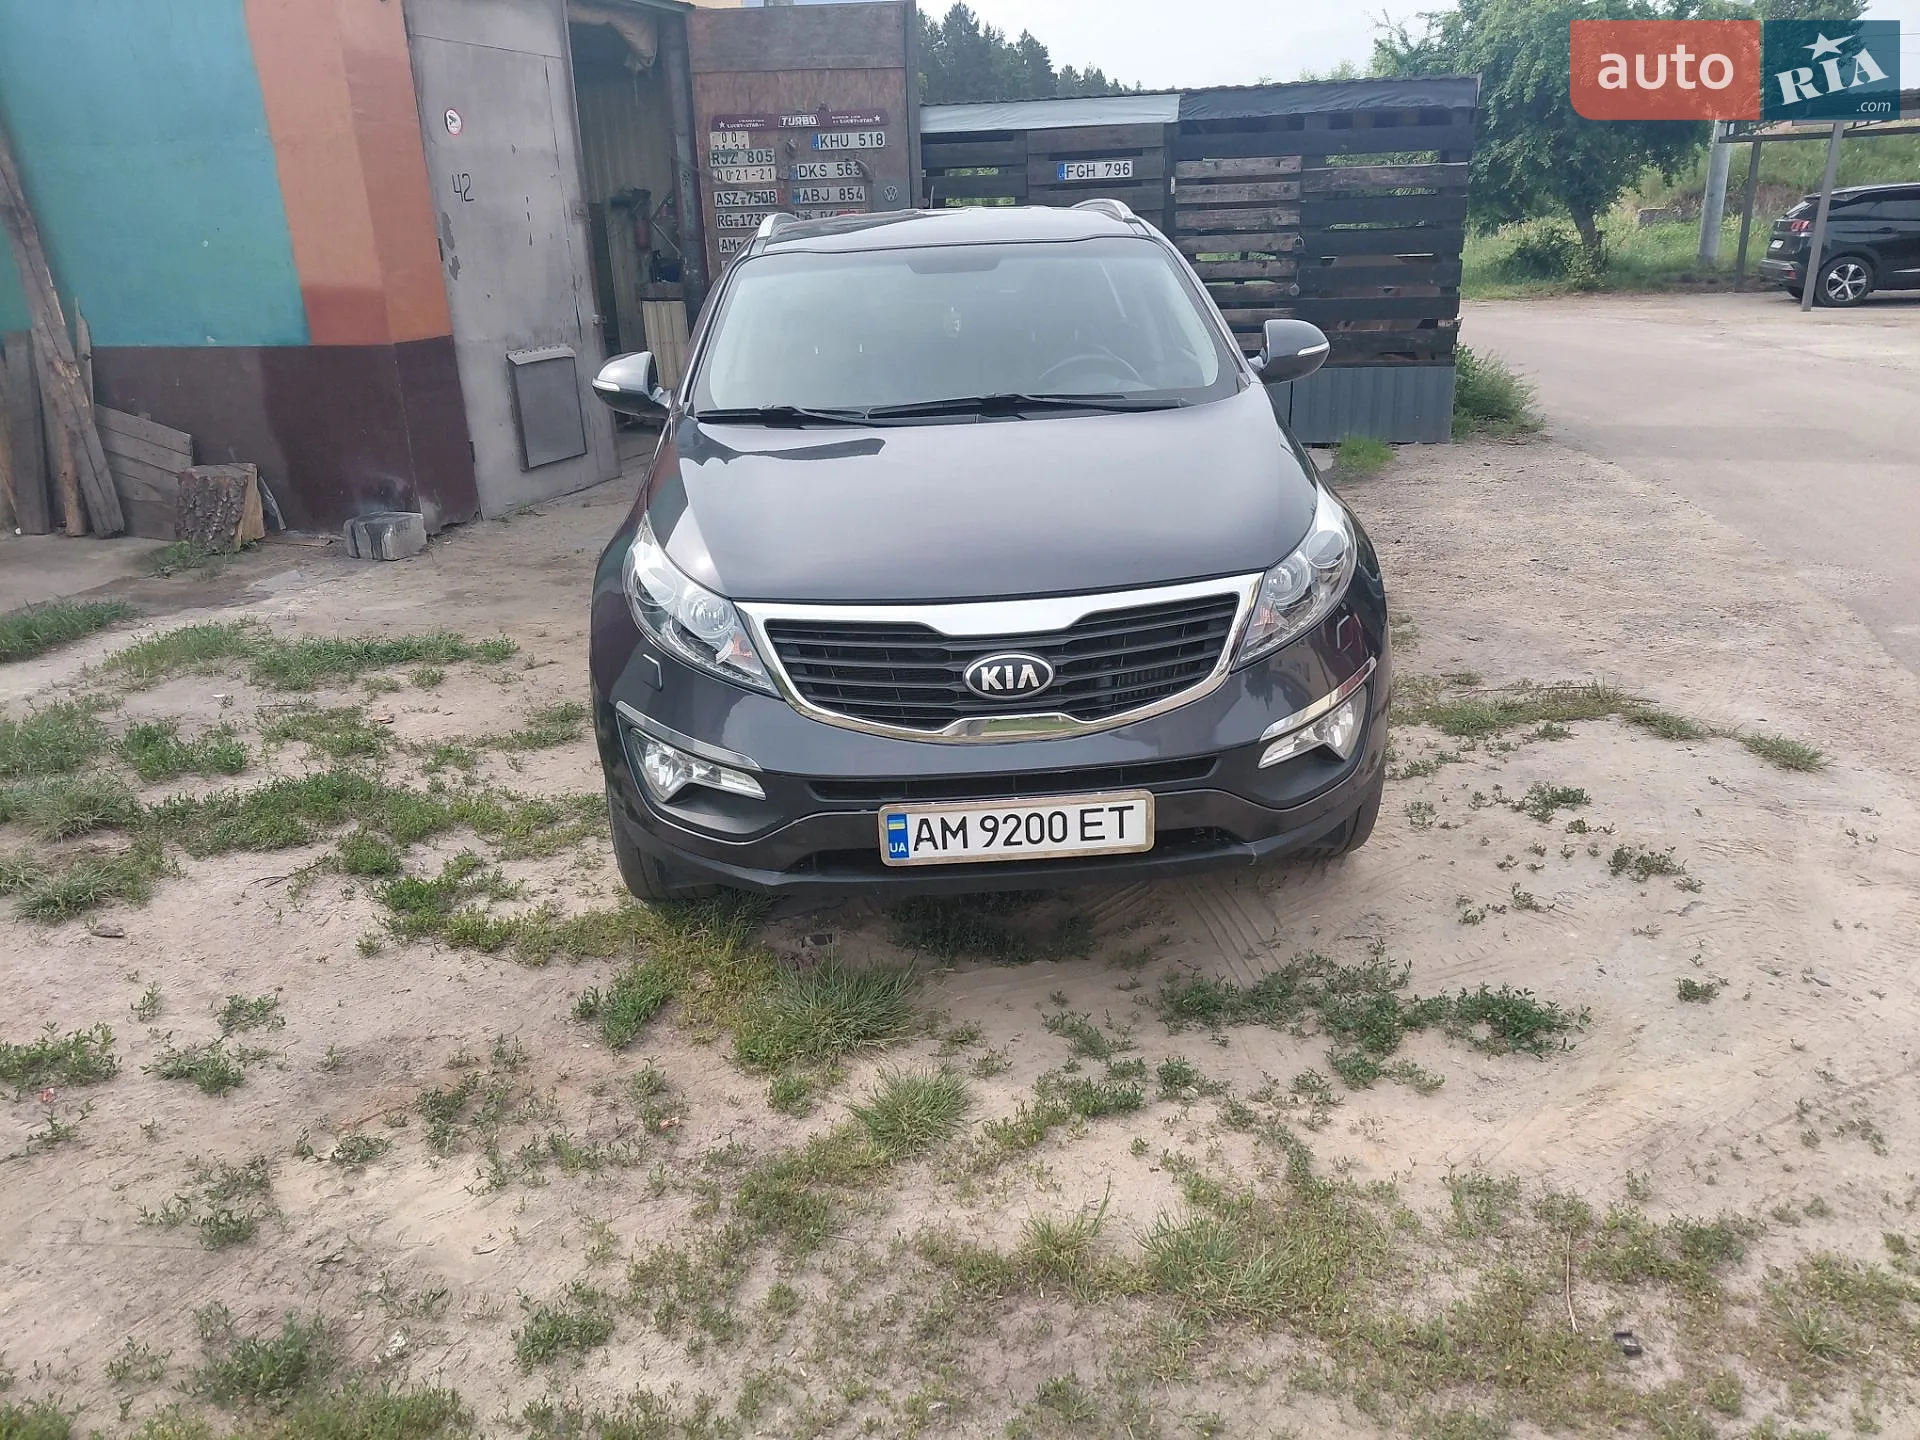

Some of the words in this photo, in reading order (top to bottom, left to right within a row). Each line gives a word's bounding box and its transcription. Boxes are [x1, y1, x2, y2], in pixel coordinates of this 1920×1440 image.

[781, 115, 818, 126] TURBO
[820, 134, 849, 149] KHU
[859, 132, 884, 147] 518
[747, 150, 773, 164] 805
[798, 164, 827, 179] DKS
[1066, 164, 1096, 179] FGH
[1105, 162, 1130, 177] 796
[451, 173, 475, 203] 42
[802, 188, 830, 202] ABJ
[839, 187, 863, 201] 854
[980, 664, 1040, 691] KIA
[889, 843, 908, 853] UA
[913, 815, 969, 852] AM
[979, 810, 1068, 848] 9200
[1079, 805, 1135, 842] ET
